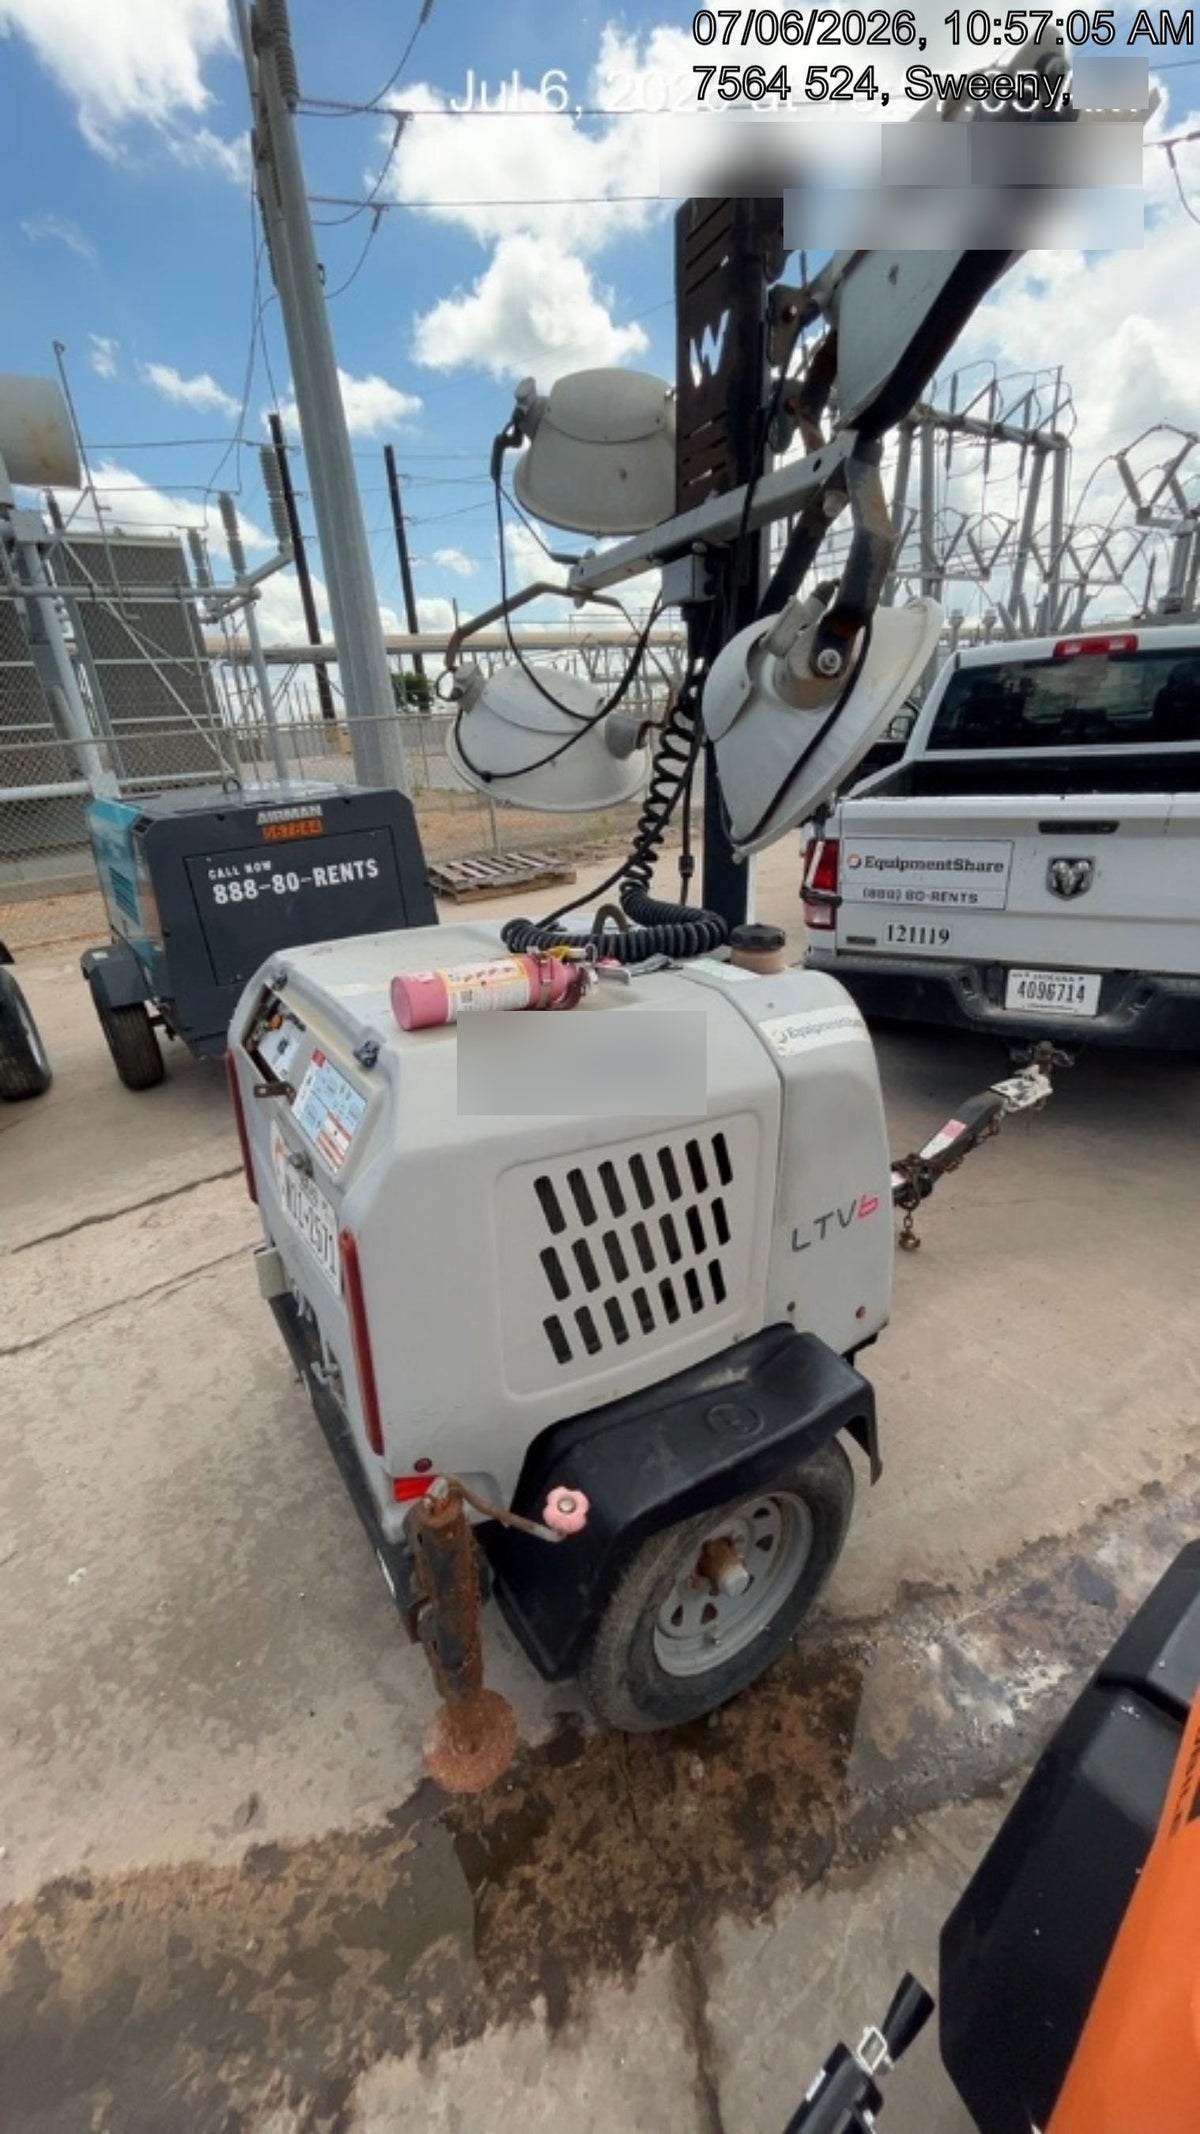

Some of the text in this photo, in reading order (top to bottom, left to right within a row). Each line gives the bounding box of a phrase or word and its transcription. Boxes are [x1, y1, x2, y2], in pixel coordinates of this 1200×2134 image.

[207, 860, 272, 880] CALL NOW
[864, 855, 1005, 873] EquipmentShare
[212, 858, 380, 905] 888-80-RENTS
[887, 923, 951, 945] 121119
